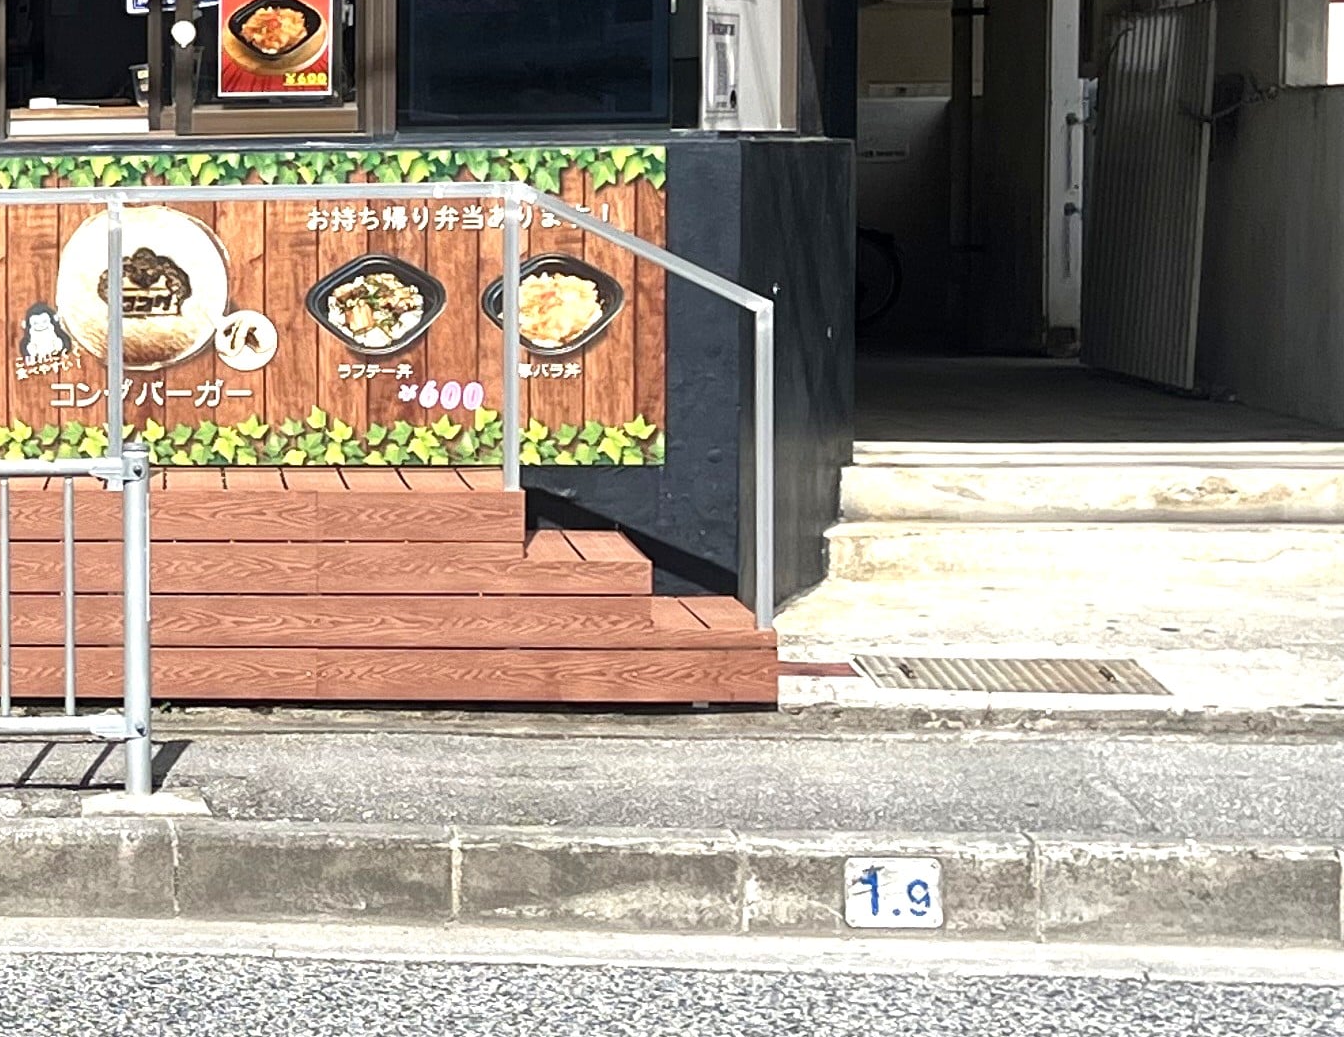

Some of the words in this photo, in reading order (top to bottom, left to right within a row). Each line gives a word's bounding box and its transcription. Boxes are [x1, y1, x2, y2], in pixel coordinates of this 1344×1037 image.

[337, 363, 414, 380] ラフテー丼
[397, 379, 485, 411] ¥600
[852, 864, 932, 917] 1.9
